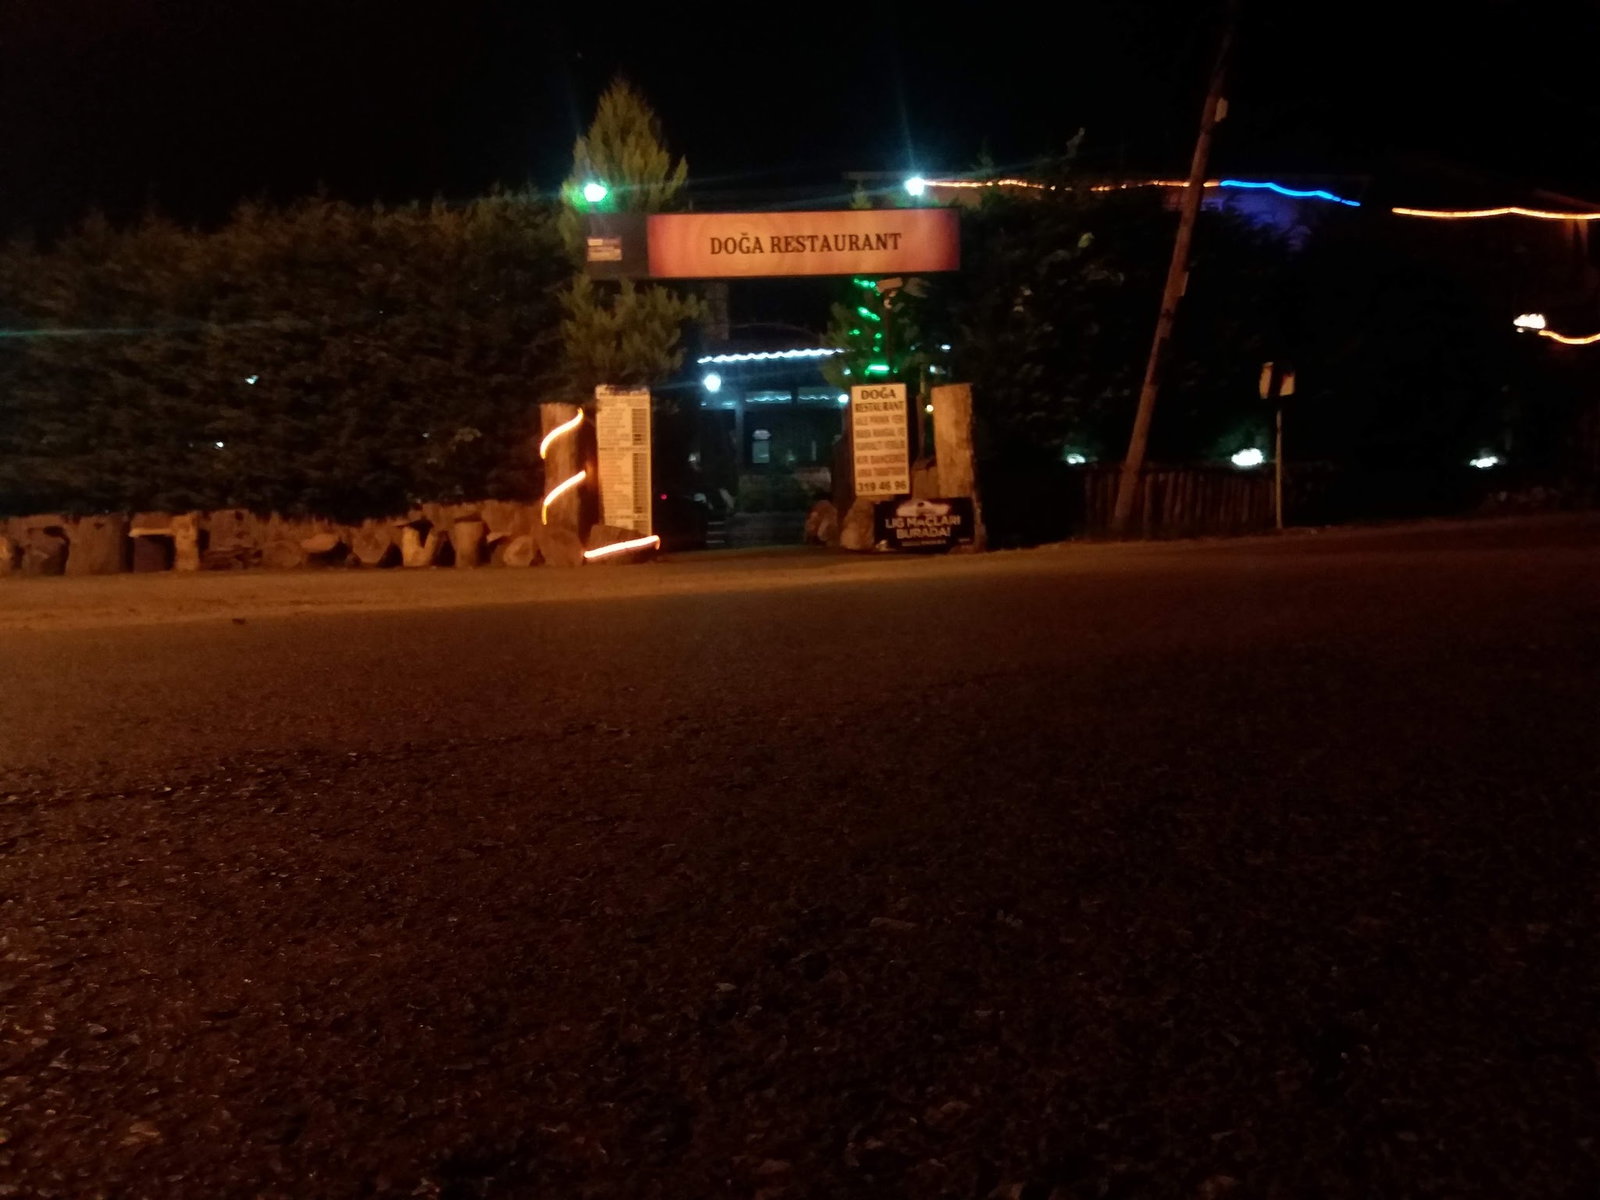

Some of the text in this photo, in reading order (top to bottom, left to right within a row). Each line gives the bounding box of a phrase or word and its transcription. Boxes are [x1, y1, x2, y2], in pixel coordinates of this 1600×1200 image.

[710, 232, 902, 255] DOĞA RESTAURANT
[861, 387, 896, 400] DOĞA
